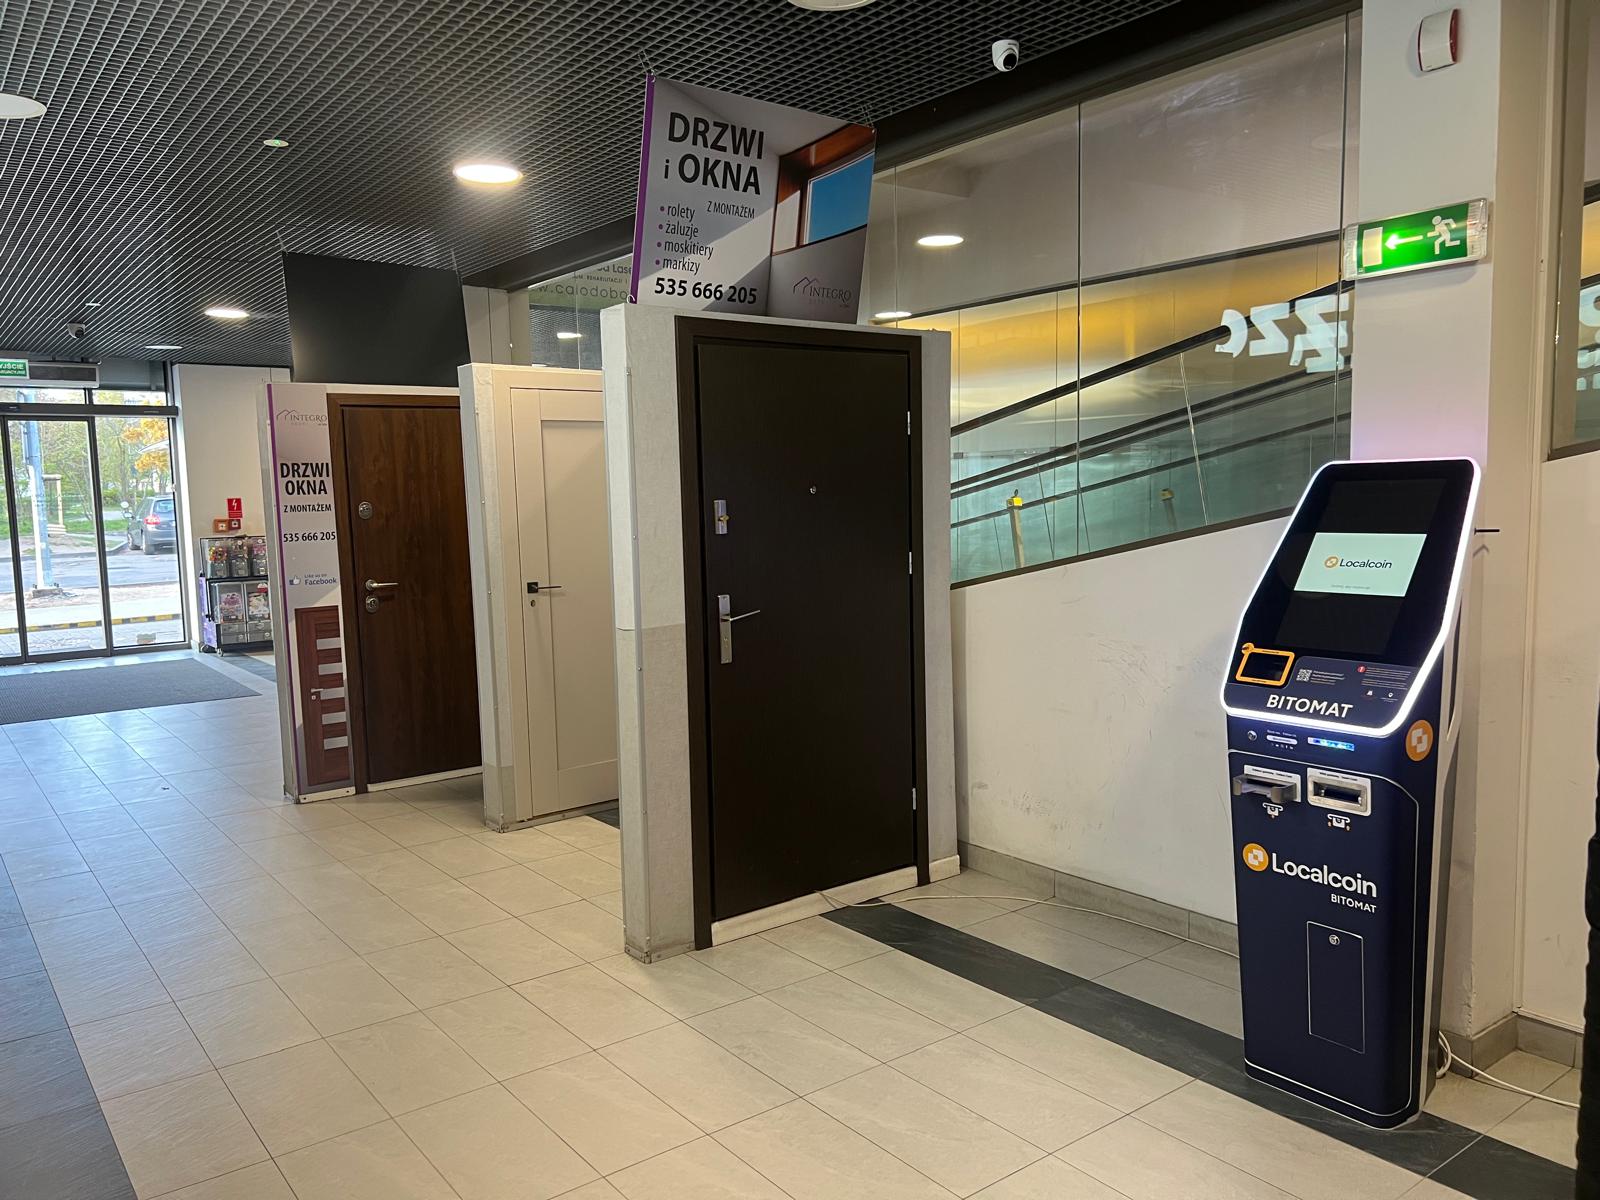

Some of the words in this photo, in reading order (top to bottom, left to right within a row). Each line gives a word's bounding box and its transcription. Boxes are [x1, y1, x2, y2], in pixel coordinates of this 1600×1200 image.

[667, 111, 765, 160] DRZWI
[663, 158, 670, 180] i
[678, 153, 761, 196] OKNA
[667, 203, 695, 222] rolety
[706, 200, 714, 213] Z
[713, 202, 756, 219] MONTAŻEM
[665, 219, 699, 240] żaluzje
[664, 239, 714, 260] moskitiery
[612, 263, 632, 275] Lase
[662, 256, 701, 276] markizy
[654, 277, 688, 297] 535
[691, 281, 724, 301] 666
[726, 285, 758, 305] 205
[809, 286, 852, 304] INTEGRO
[290, 414, 328, 423] INTEGRO
[279, 462, 330, 479] DRZWI
[285, 479, 328, 496] OKNA
[283, 504, 289, 513] Z
[289, 501, 332, 513] MONTAŻEM
[283, 532, 300, 543] 535
[301, 532, 318, 542] 666
[319, 531, 336, 541] 205
[1339, 558, 1393, 569] Localcoin
[304, 576, 337, 586] Facebook
[1266, 694, 1354, 719] BITOMAT
[1271, 852, 1377, 898] Localcoin
[1330, 893, 1377, 914] BITOMAT
